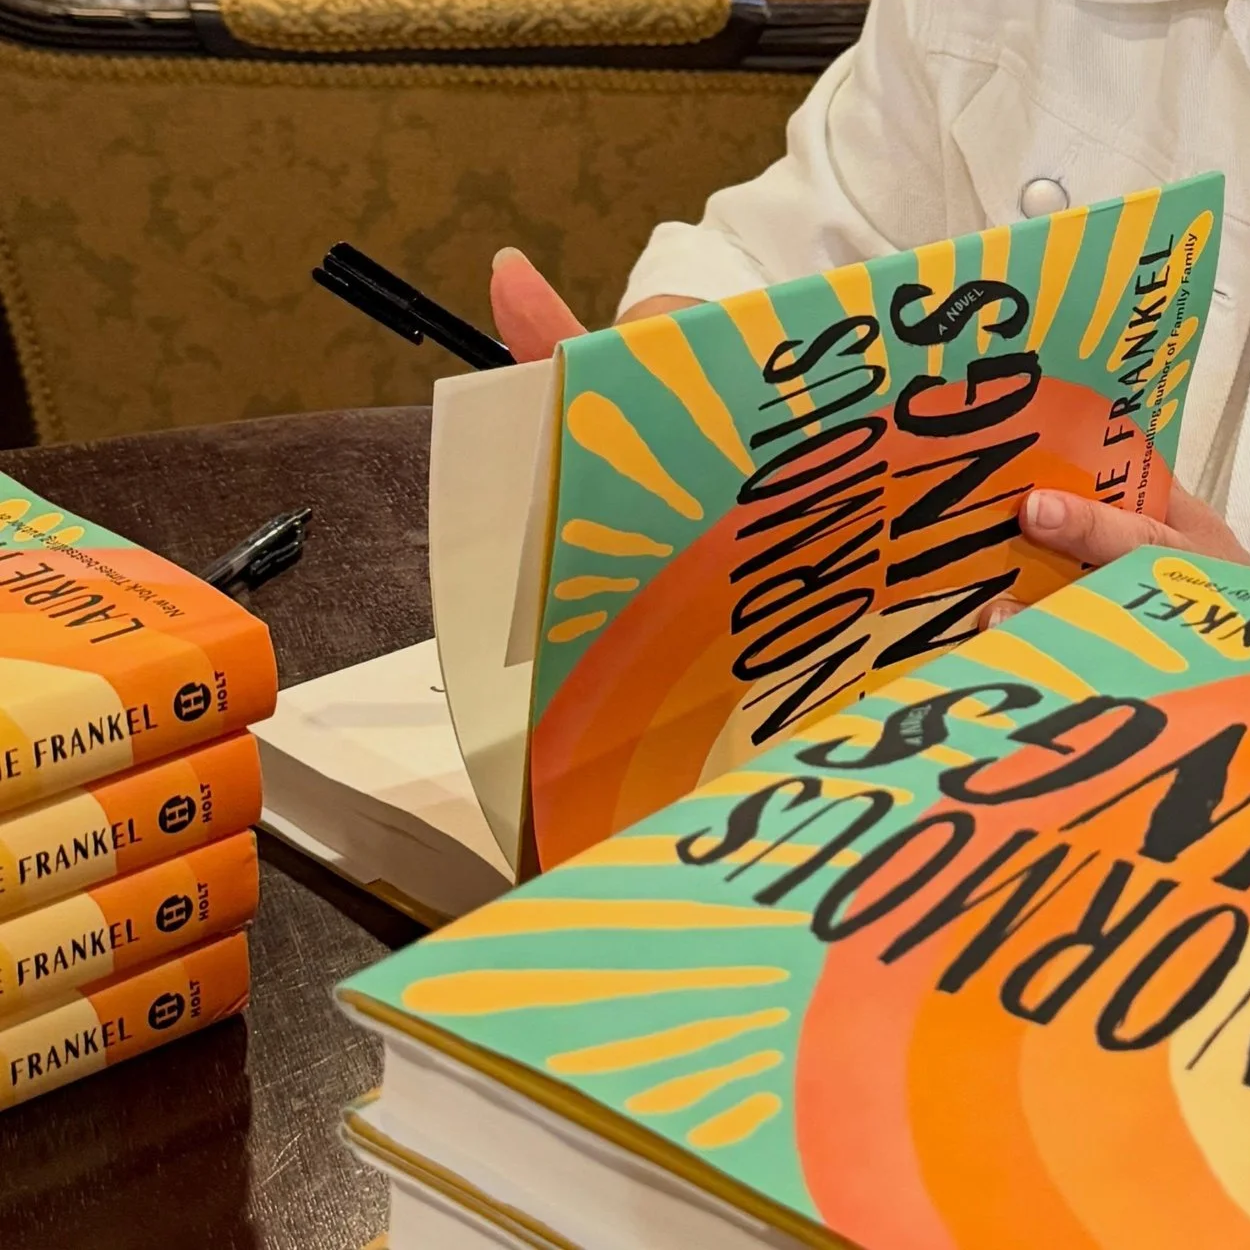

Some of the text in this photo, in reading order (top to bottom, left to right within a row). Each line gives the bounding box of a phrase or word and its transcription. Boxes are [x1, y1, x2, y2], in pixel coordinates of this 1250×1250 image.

[1181, 233, 1198, 284] Family
[946, 288, 985, 322] NOVEL
[1171, 288, 1190, 337] Family
[1103, 234, 1174, 447] FRANKEL
[1167, 342, 1177, 356] of
[1154, 360, 1172, 406] author
[1137, 408, 1161, 489] bestselling
[730, 315, 888, 746] NORMOUS
[1162, 570, 1229, 593] Family
[214, 670, 229, 712] HOLT
[33, 703, 158, 770] FRANKEL
[200, 783, 213, 823] HOLT
[18, 818, 143, 885] FRANKEL
[197, 882, 210, 921] HOLT
[17, 918, 140, 986] FRANKEL
[189, 979, 201, 1018] HOLT
[10, 1017, 133, 1086] FRANKEL
